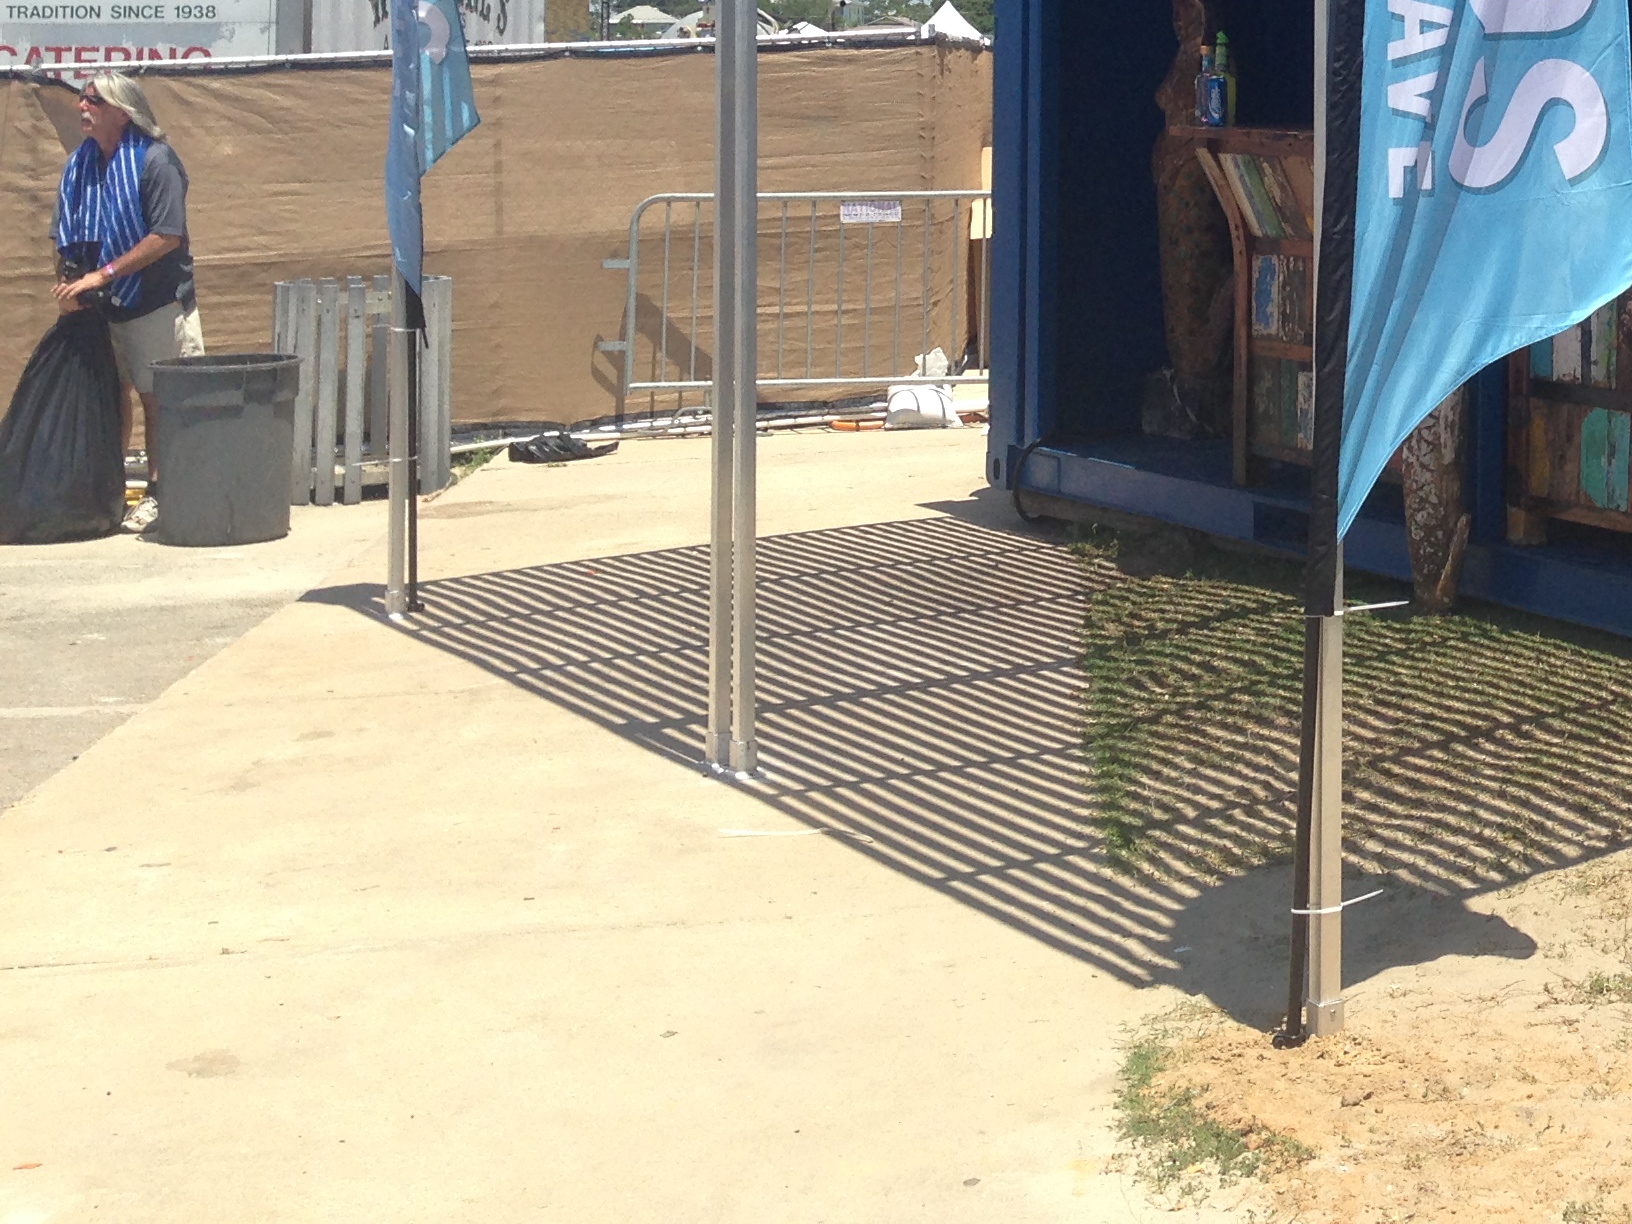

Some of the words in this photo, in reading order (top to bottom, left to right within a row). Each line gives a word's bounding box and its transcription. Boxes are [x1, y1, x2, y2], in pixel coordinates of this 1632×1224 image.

[6, 4, 101, 20] TRADITION
[110, 4, 165, 19] SINCE
[174, 4, 216, 19] 1938
